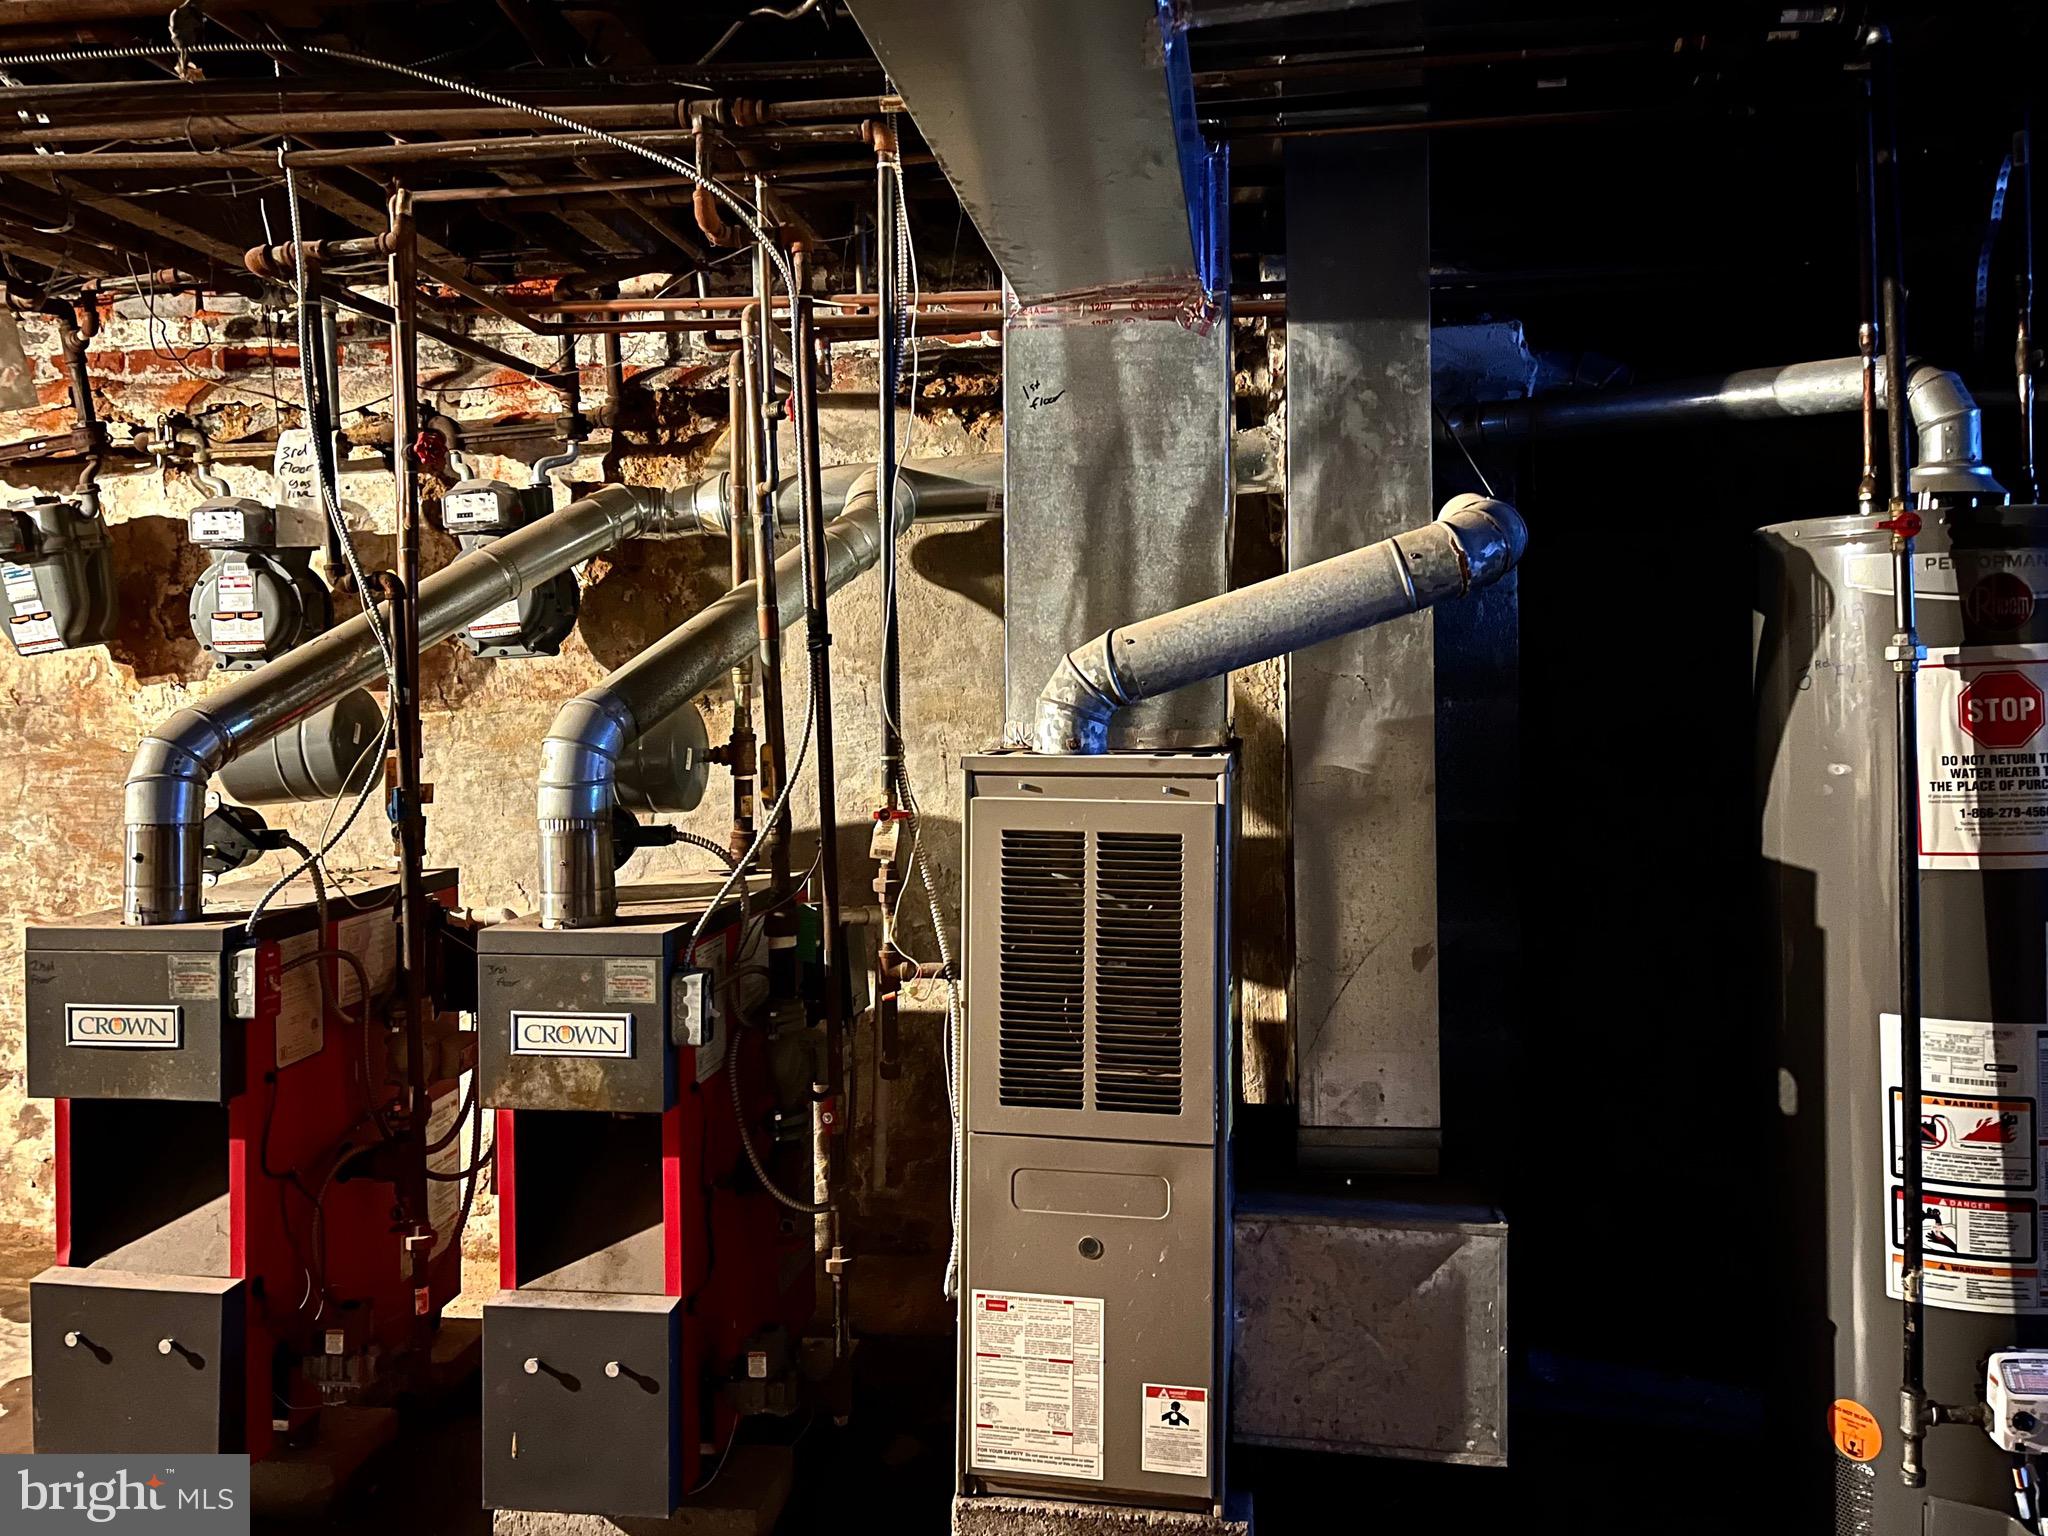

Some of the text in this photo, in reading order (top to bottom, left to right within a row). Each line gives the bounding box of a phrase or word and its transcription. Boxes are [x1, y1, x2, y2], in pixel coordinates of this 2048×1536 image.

[1090, 302, 1113, 312] 12/07
[1022, 380, 1041, 400] 1st
[1029, 389, 1066, 410] floor
[281, 443, 308, 460] 3rd
[288, 479, 312, 490] gas
[287, 490, 316, 500] line
[1926, 553, 2048, 571] PEORMAN
[1974, 585, 2031, 624] Rheem
[1967, 696, 2036, 723] STOP
[1941, 755, 1959, 766] DO
[1961, 754, 1986, 766] NOT
[1990, 753, 2036, 765] RETURN
[1950, 768, 1992, 779] WATER
[1995, 766, 2041, 778] HEATER
[1929, 781, 1953, 792] THE
[1956, 781, 1996, 792] PLACE
[2000, 780, 2016, 792] OF
[1959, 806, 2048, 819] 1-866-279-456
[78, 1016, 168, 1036] CROWN
[524, 1024, 619, 1045] CROWN
[1943, 1099, 1994, 1110] WARNING
[1949, 1200, 1991, 1209] DANGER
[1951, 1265, 1994, 1275] WARNING
